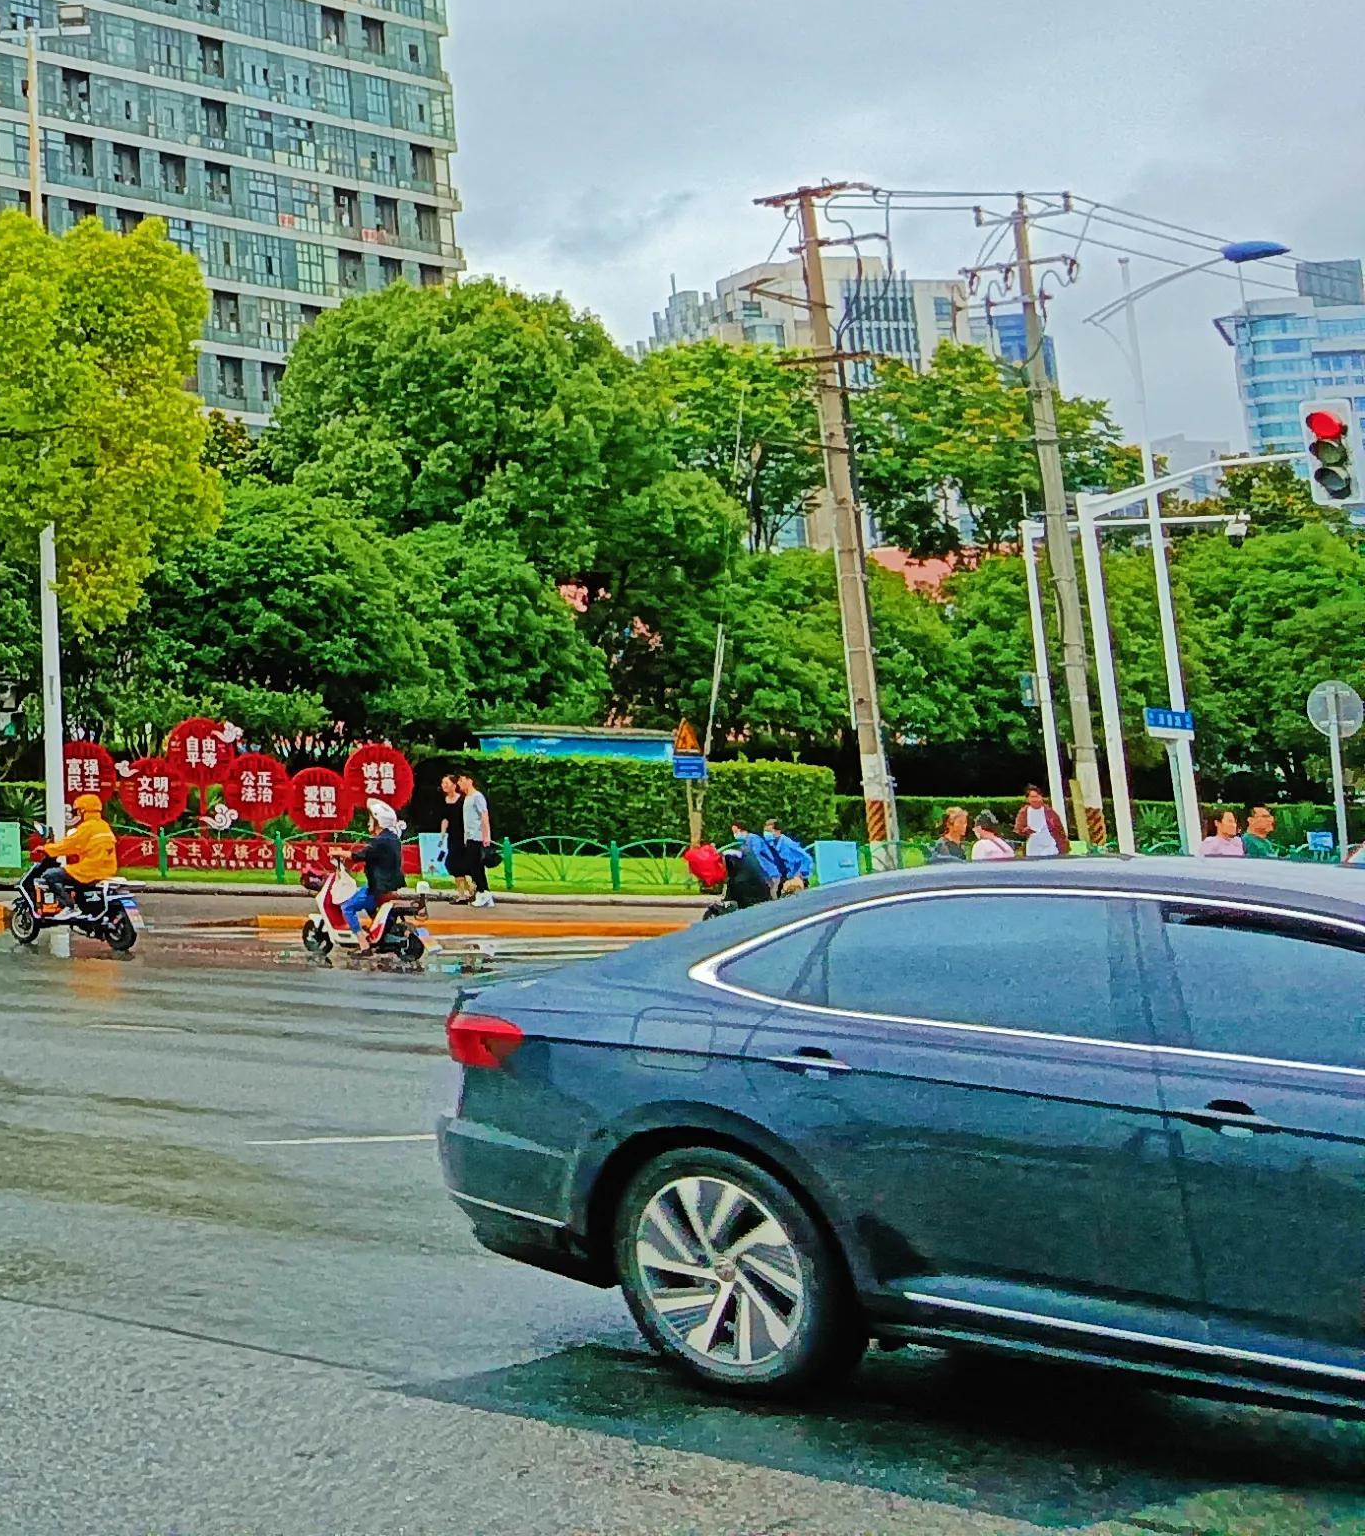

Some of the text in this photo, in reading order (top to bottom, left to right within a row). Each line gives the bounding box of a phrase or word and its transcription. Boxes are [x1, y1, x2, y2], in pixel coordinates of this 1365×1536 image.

[185, 735, 216, 752] 自由
[65, 758, 100, 776] 富强
[185, 751, 217, 768] 平等
[240, 771, 272, 787] 公正
[362, 762, 395, 779] 诚信
[67, 775, 101, 792] 民主
[137, 775, 169, 793] 文明
[364, 779, 396, 795] 友善
[138, 792, 169, 808] 和谐
[241, 786, 273, 803] 法治
[303, 785, 336, 802] 爱国
[304, 802, 337, 818] 敬业
[141, 840, 344, 861] 社会主义核心价值
